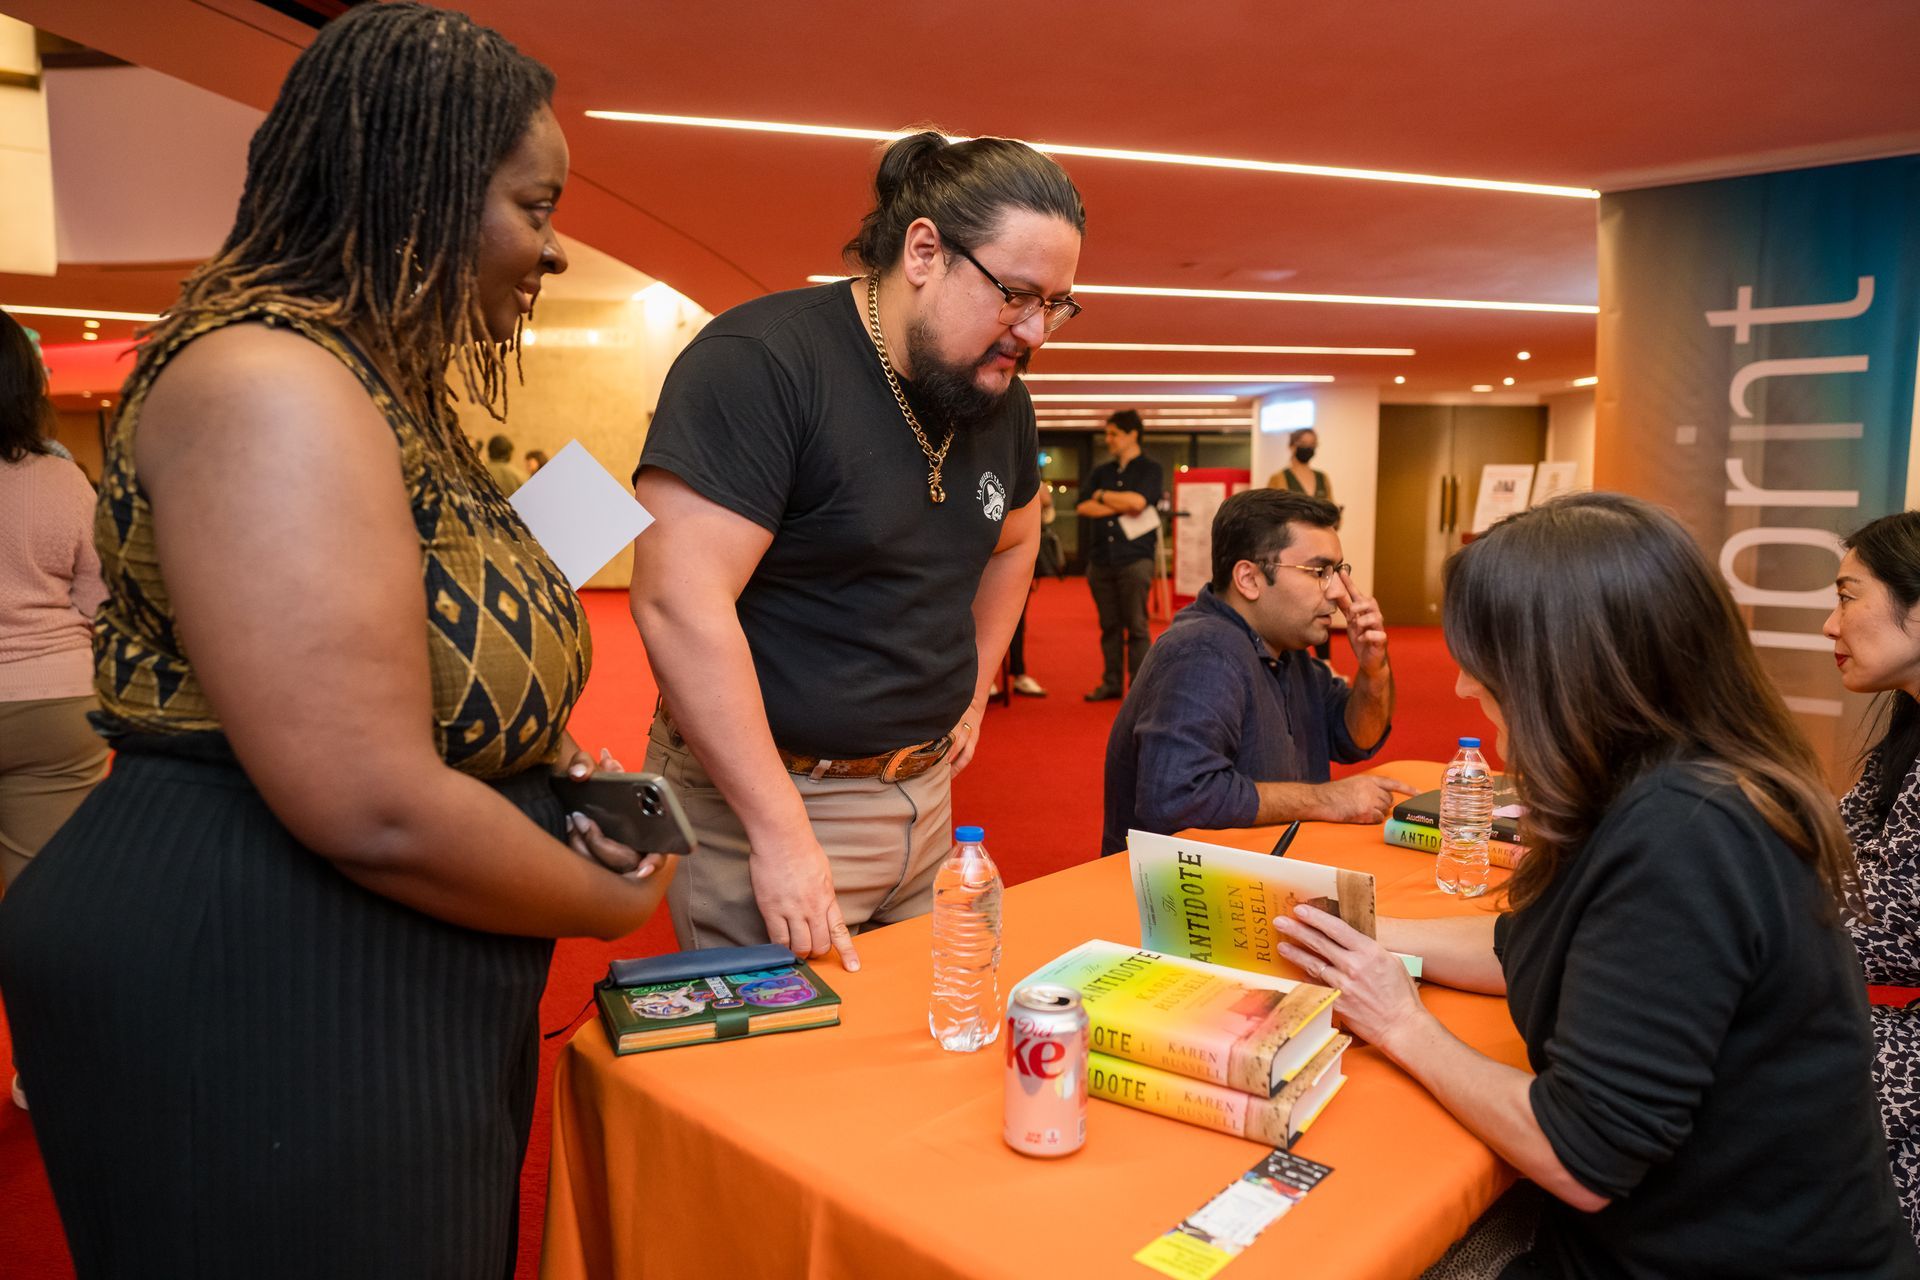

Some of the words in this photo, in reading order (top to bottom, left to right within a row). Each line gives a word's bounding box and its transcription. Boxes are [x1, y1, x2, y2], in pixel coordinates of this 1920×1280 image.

[1675, 275, 1875, 716] print
[1406, 813, 1434, 825] Audition
[1162, 894, 1177, 917] The
[1178, 851, 1212, 963] ANTIDOTE
[1227, 885, 1248, 950] KAREN
[1249, 881, 1271, 962] RUSSELL
[1082, 951, 1162, 1002] ANTIDOTE
[1136, 970, 1186, 1001] KAREN
[1154, 973, 1216, 1011] RUSSELL
[1018, 1016, 1054, 1039] Diet
[1007, 1016, 1066, 1080] ke
[1168, 1042, 1217, 1063] KAREN
[1161, 1055, 1224, 1081] RUSSELL
[1088, 1069, 1146, 1102] DOTE
[1177, 1105, 1240, 1131] RUSSELL
[1184, 1091, 1234, 1113] KAREN
